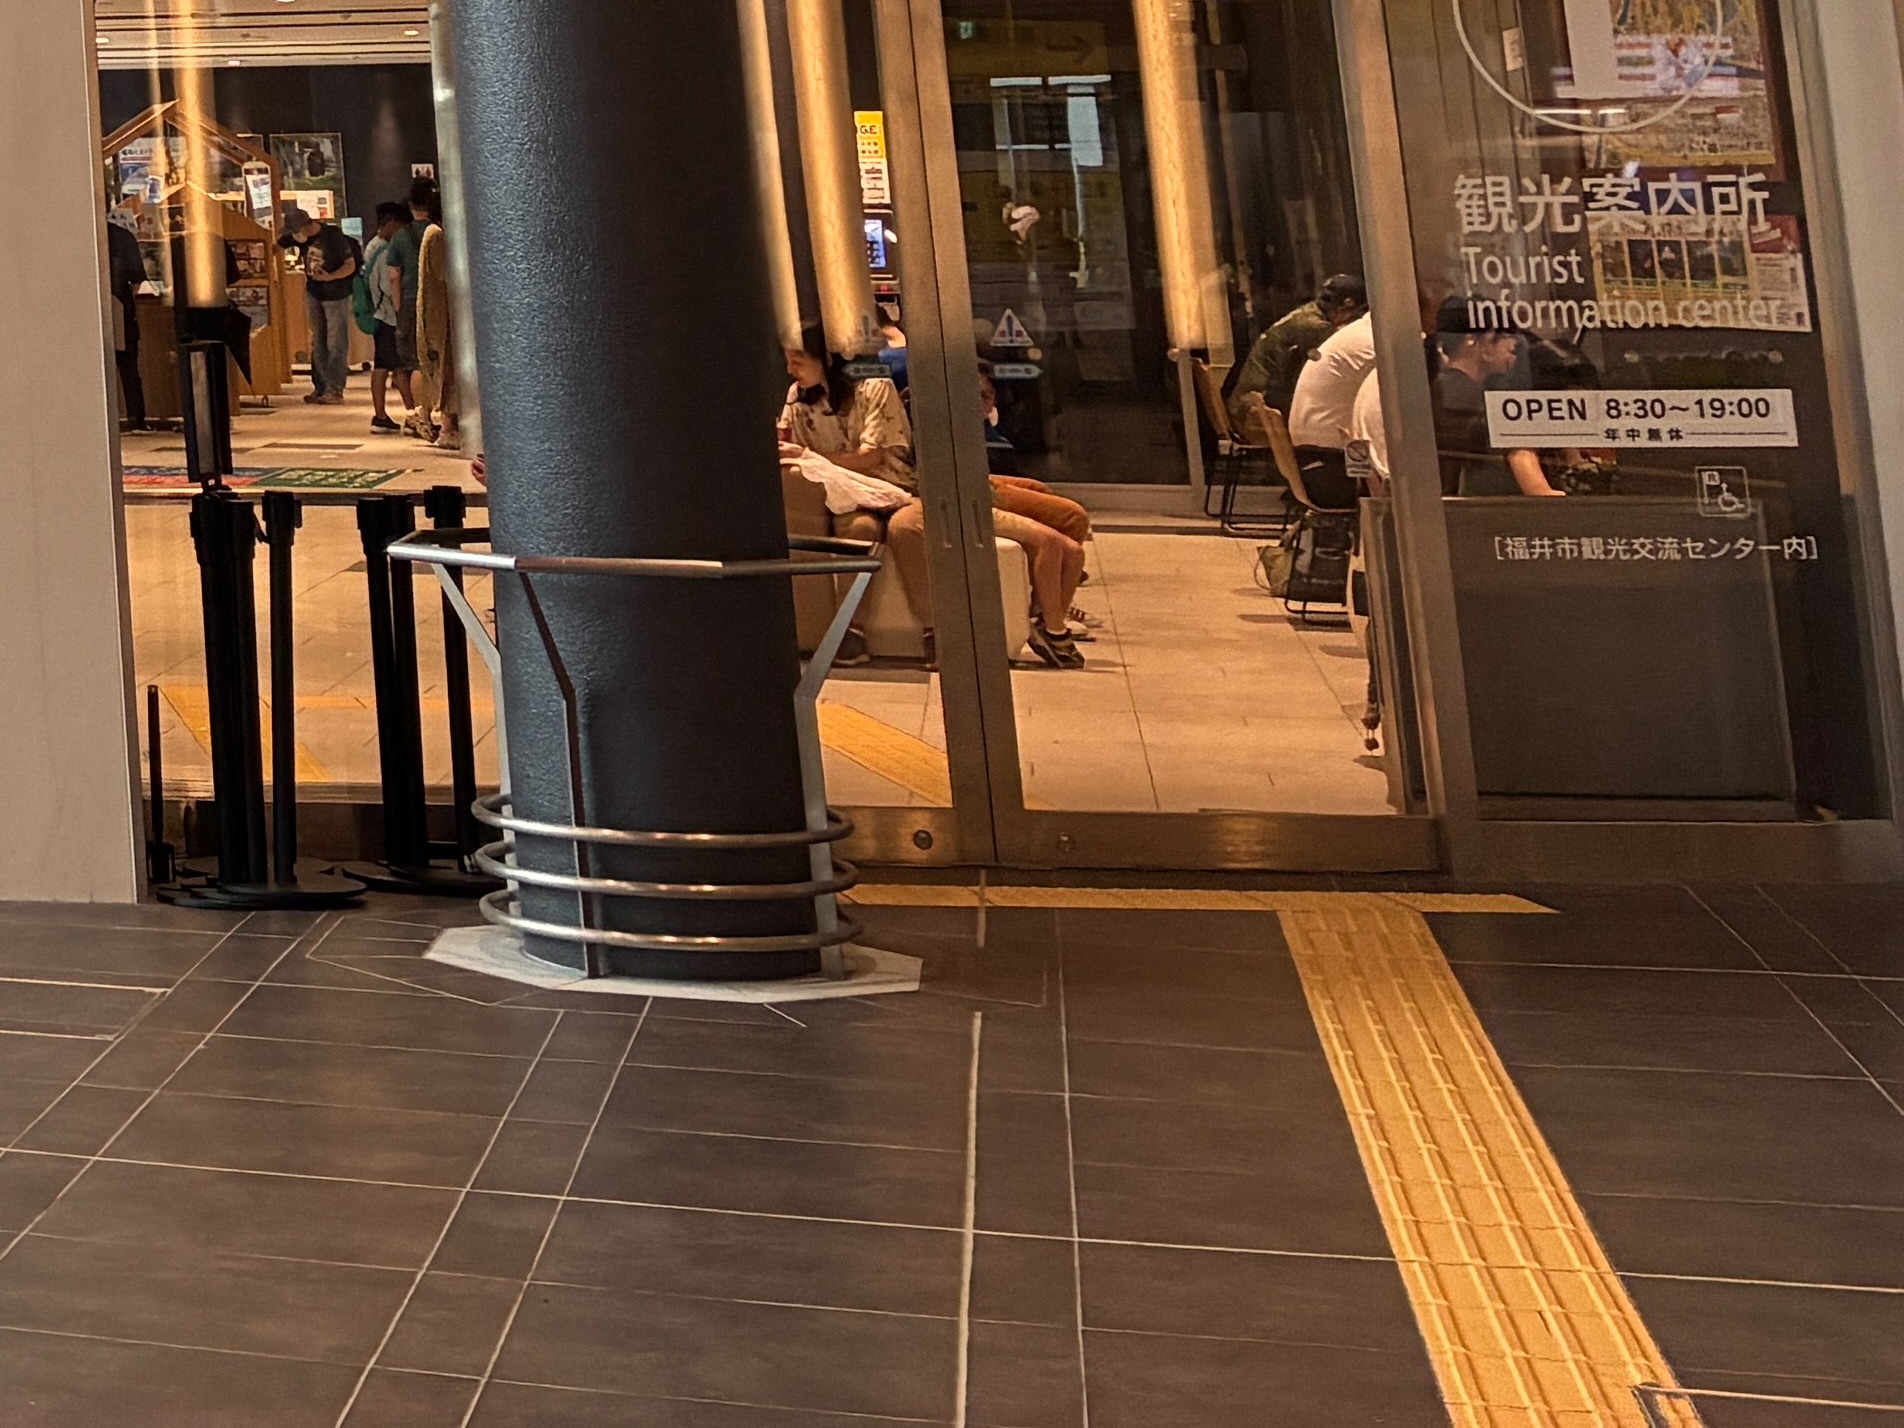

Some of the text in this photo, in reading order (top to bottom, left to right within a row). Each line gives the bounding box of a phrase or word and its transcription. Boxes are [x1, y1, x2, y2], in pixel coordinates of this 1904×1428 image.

[1454, 172, 1770, 234] 観光案内所
[1460, 245, 1585, 285] Tourist
[1467, 290, 1782, 330] information center
[1501, 396, 1771, 422] OPEN 8:30～19:00
[1603, 426, 1684, 443] 年中無休
